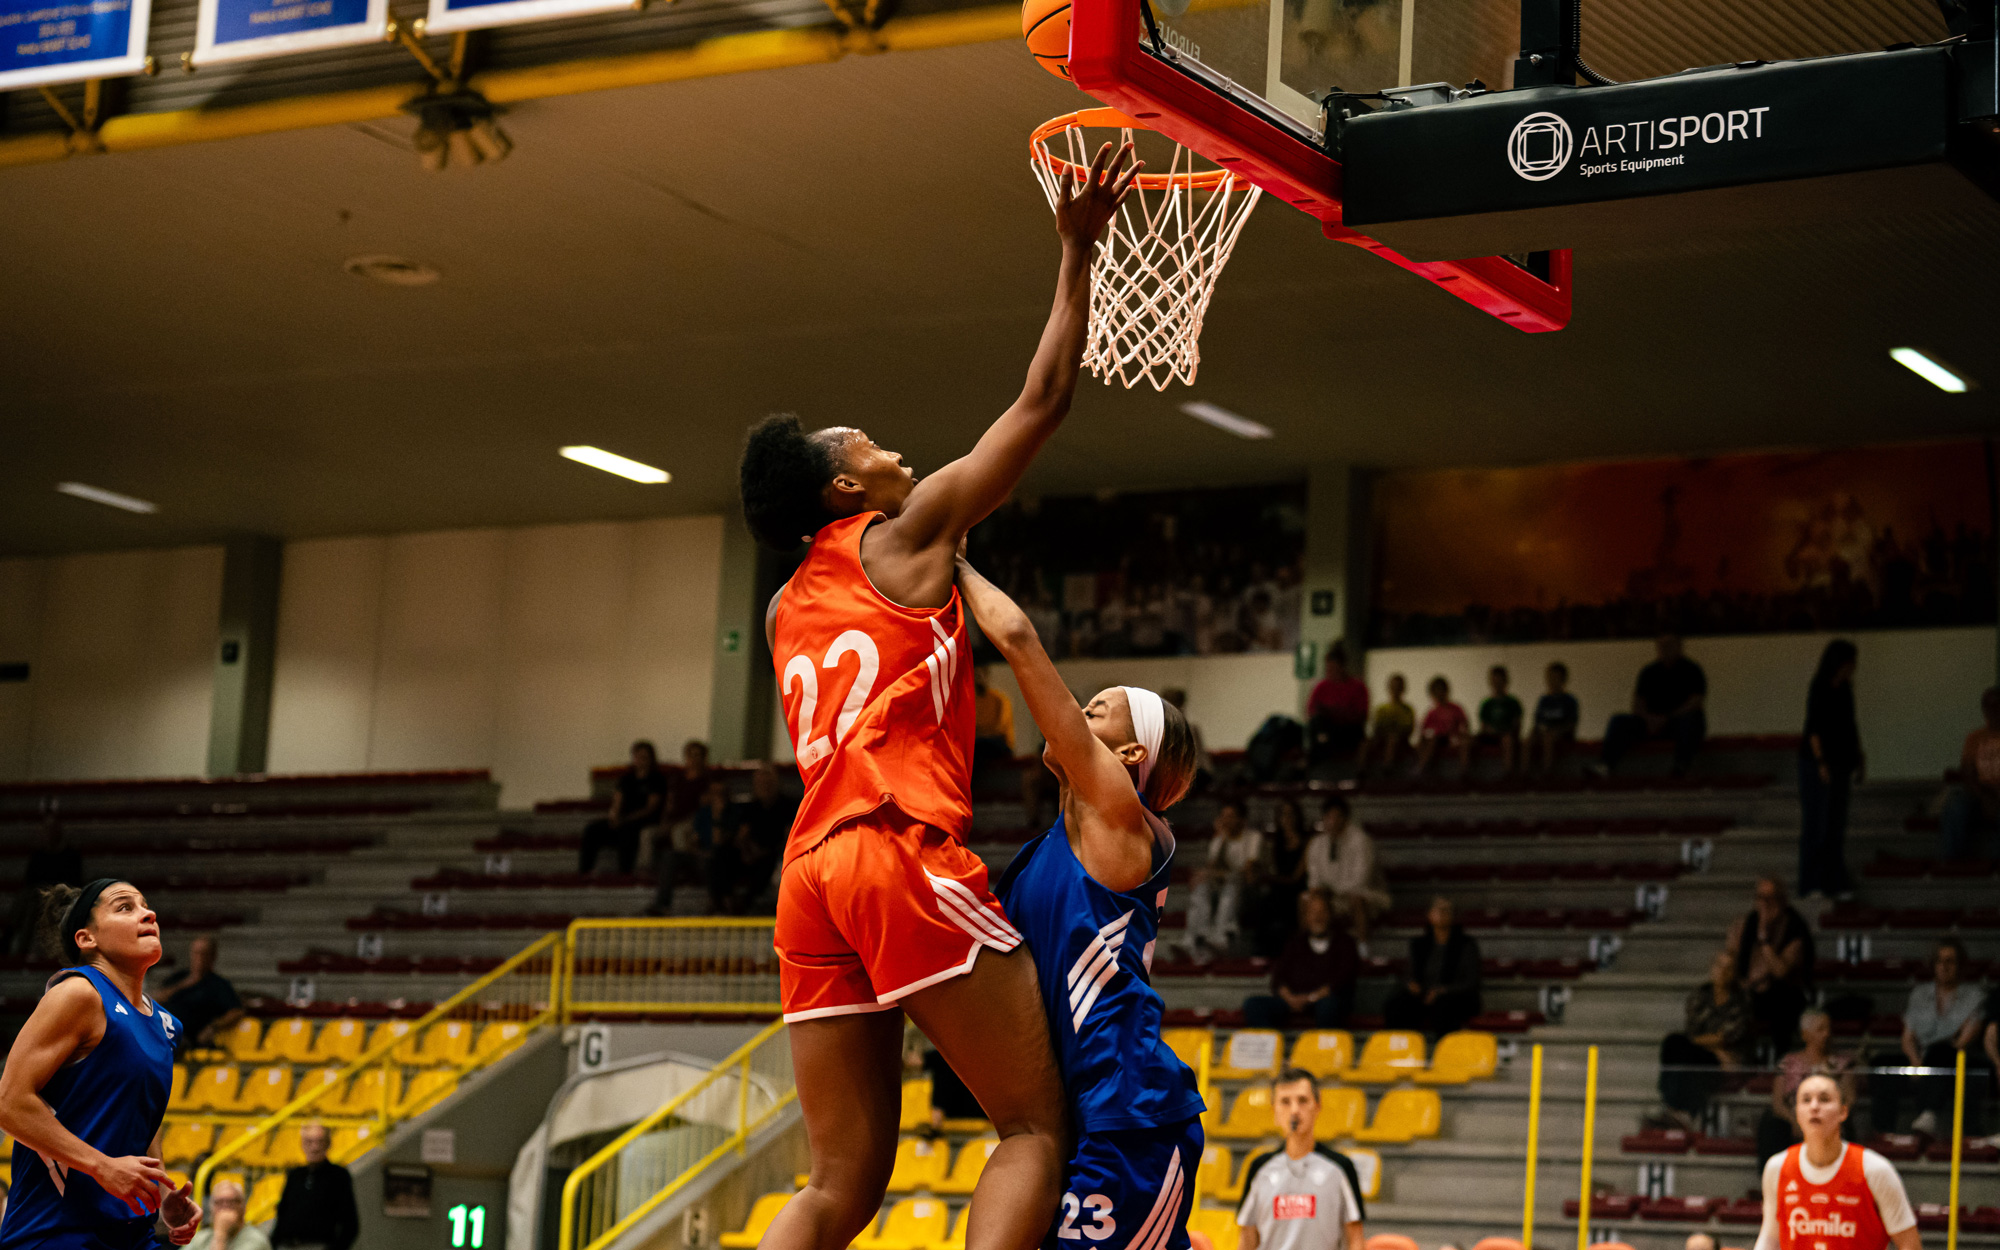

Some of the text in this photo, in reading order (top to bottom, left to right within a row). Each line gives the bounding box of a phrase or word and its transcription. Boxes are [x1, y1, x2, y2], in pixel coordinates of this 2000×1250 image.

[1579, 106, 1770, 158] ARTISPORT
[1579, 154, 1685, 178] Sports Equipment
[783, 629, 879, 771] 22
[584, 1031, 603, 1067] G
[1647, 1162, 1666, 1198] H
[447, 1203, 486, 1249] 11
[1057, 1191, 1117, 1241] 23
[1787, 1206, 1856, 1240] famila
